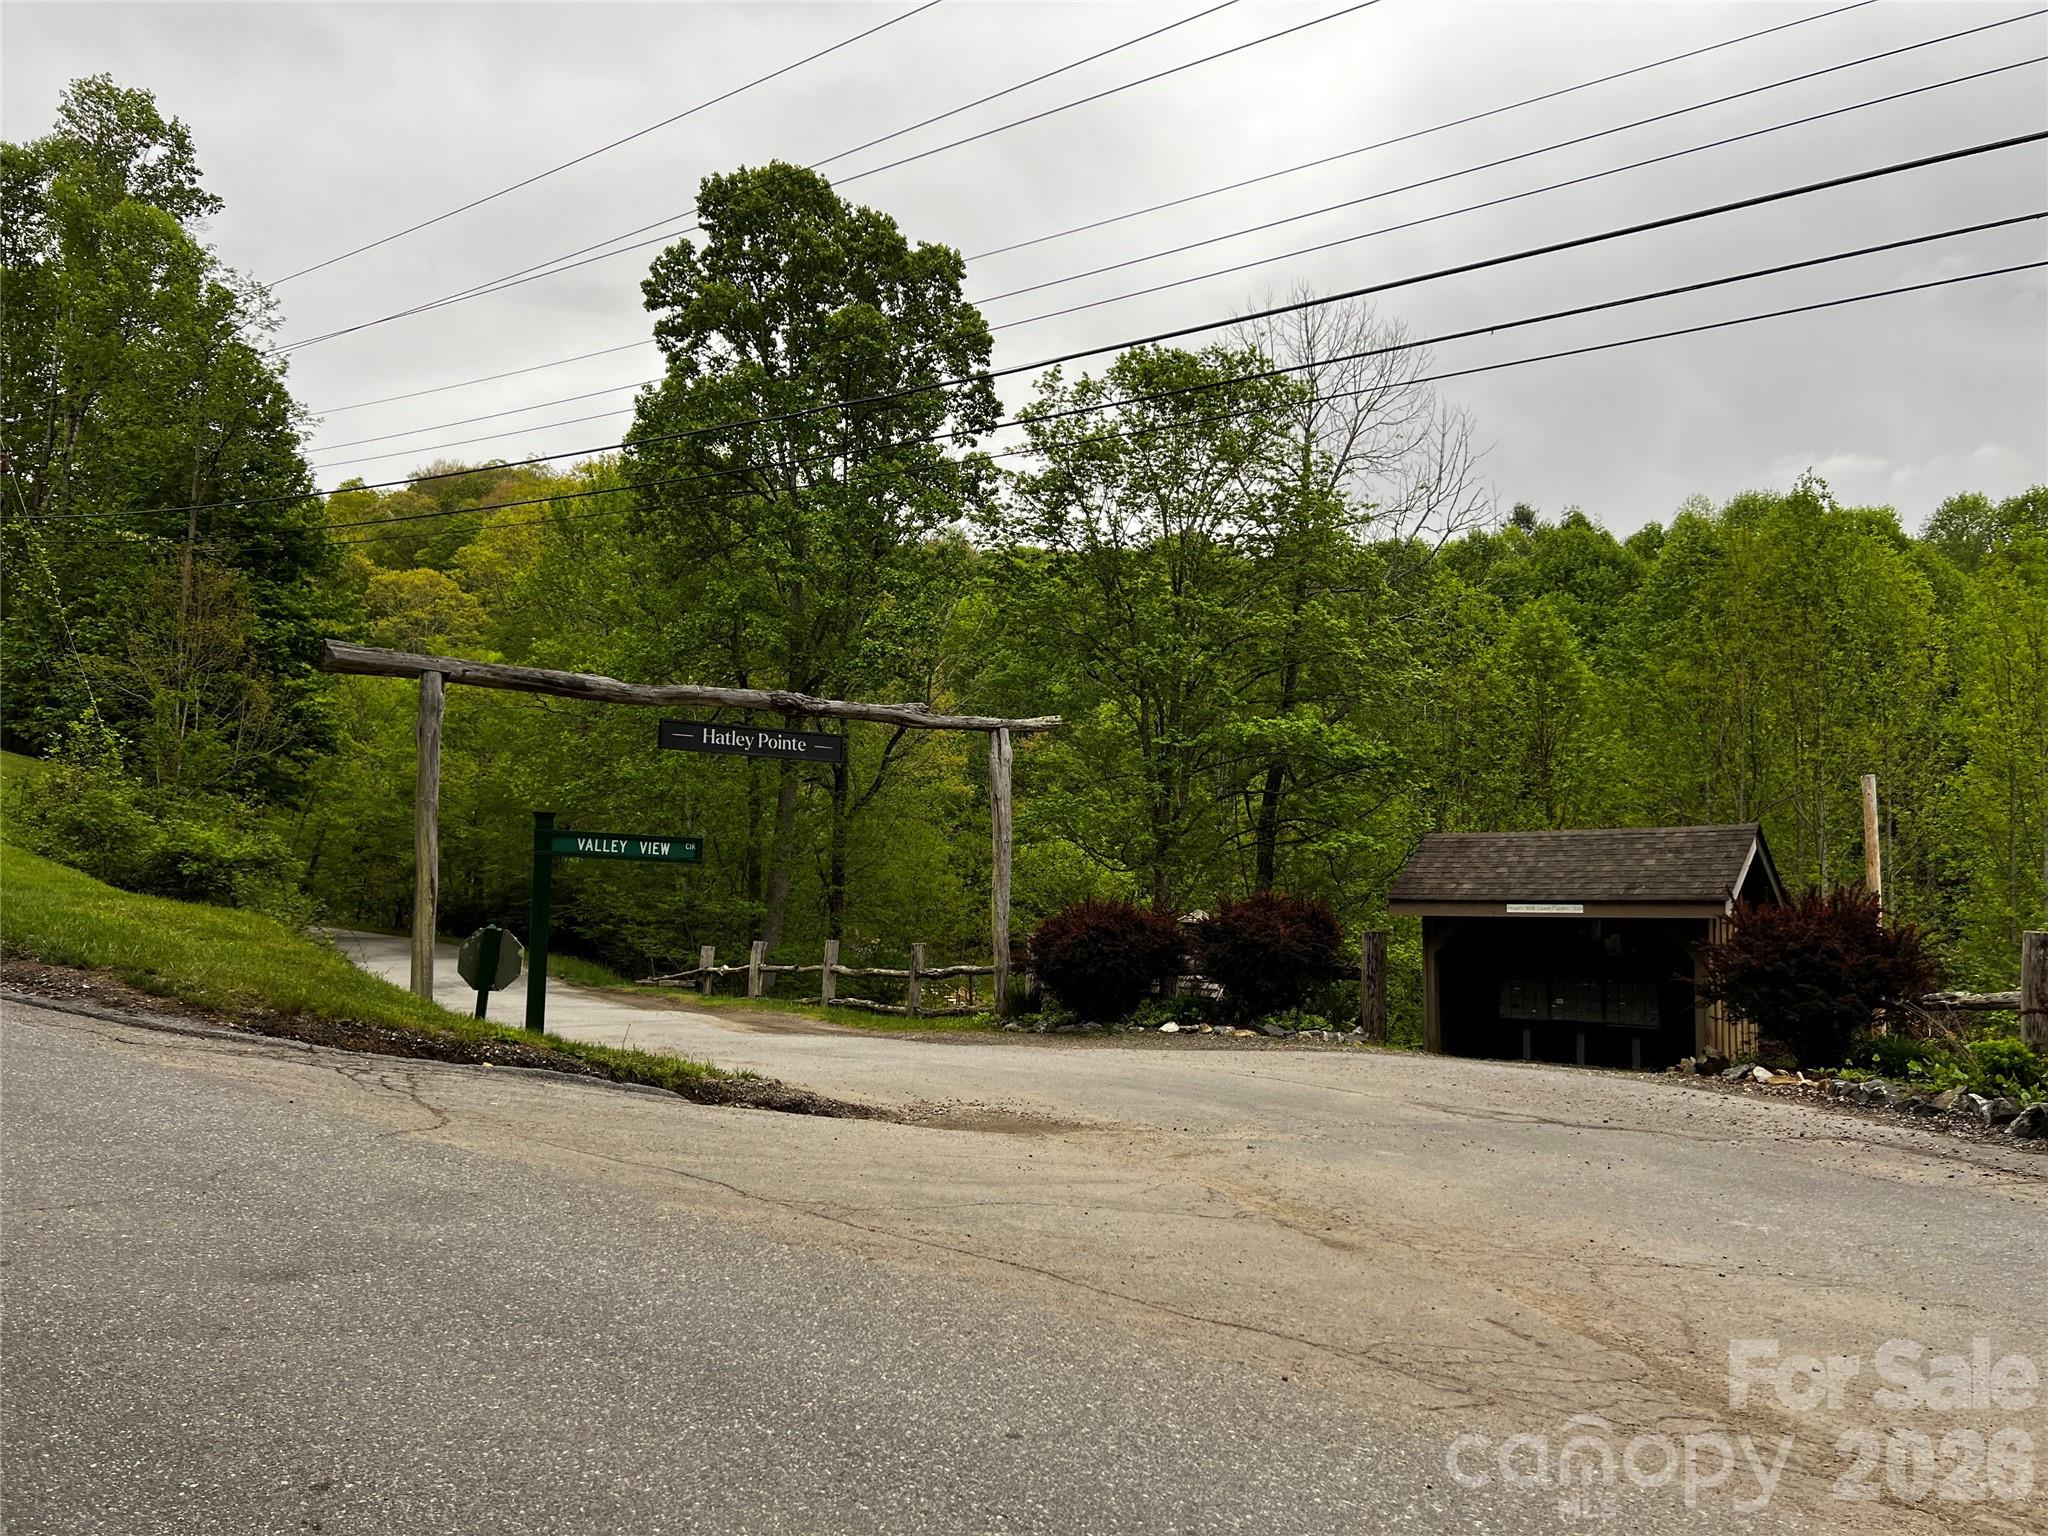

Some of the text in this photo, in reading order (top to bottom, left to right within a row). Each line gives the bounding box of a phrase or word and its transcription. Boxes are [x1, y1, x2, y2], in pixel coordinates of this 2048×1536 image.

[702, 727, 807, 752] Hatley Pointe
[577, 837, 628, 854] VALLEY
[639, 841, 671, 855] VIEW
